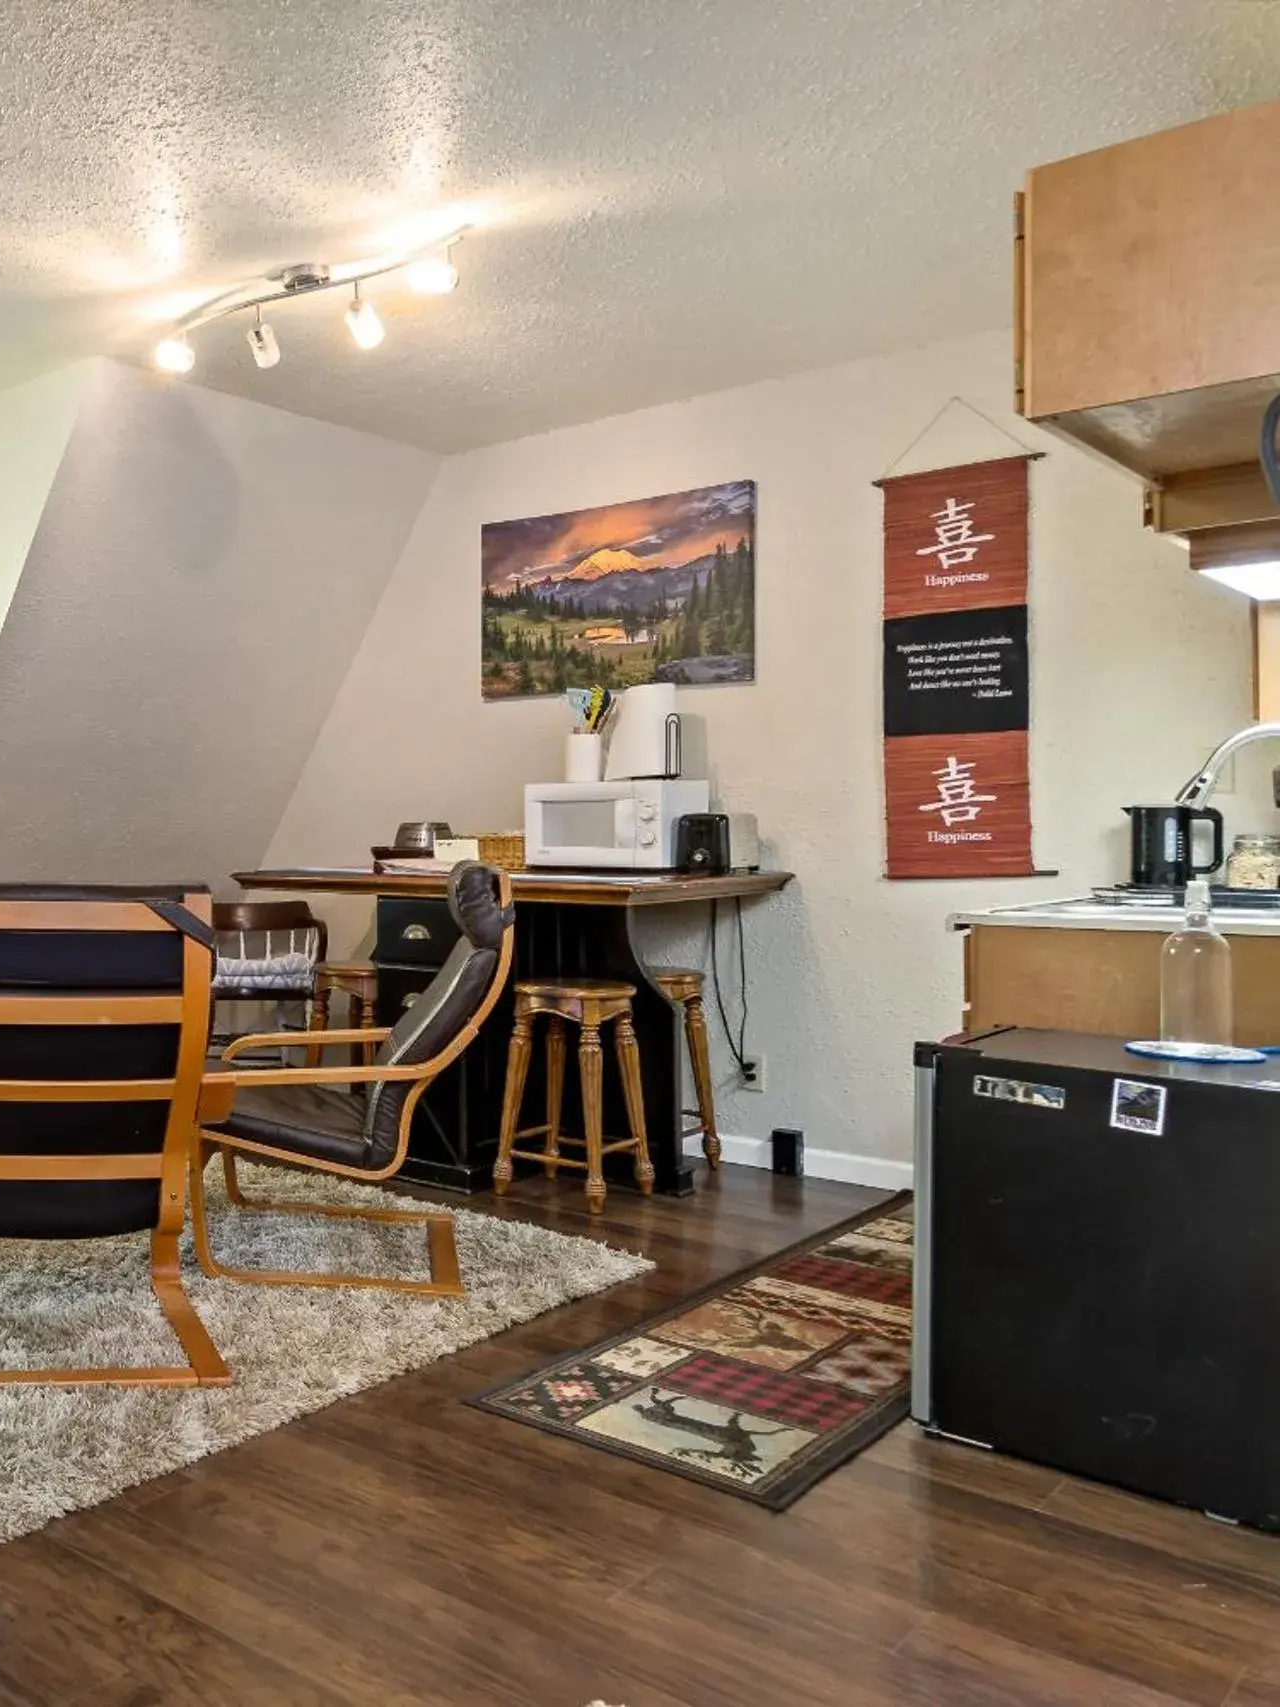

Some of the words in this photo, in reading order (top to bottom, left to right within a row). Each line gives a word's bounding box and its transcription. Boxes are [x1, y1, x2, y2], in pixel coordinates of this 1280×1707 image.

[916, 498, 996, 569] 喜
[925, 572, 990, 587] Happiness
[918, 756, 997, 826] 喜
[927, 831, 992, 844] Happiness
